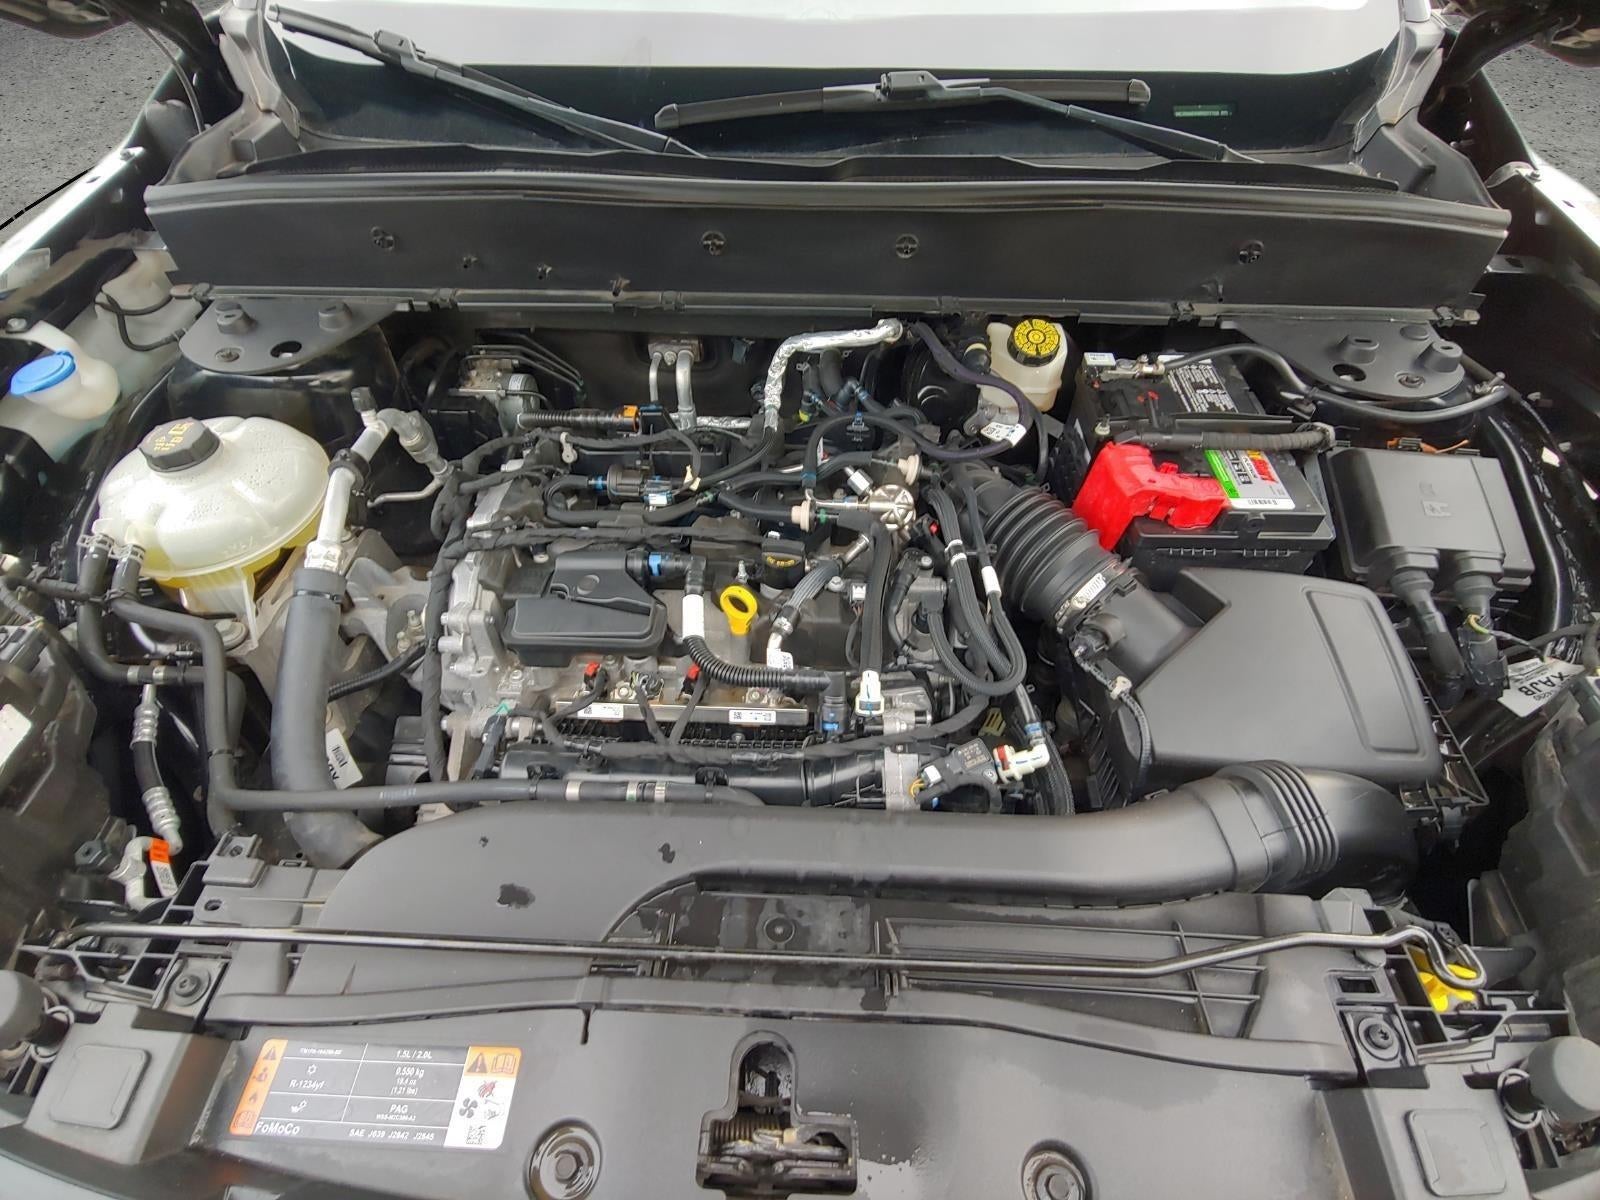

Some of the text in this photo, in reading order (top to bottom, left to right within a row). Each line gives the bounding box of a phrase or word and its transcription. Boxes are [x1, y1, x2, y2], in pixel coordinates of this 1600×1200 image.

[1518, 671, 1570, 696] XAJB
[396, 1050, 411, 1059] 1.5L
[417, 1050, 433, 1060] 2.0L
[395, 1066, 425, 1079] 0.550 kg
[289, 1079, 326, 1092] R-1234yf
[389, 1104, 409, 1114] PAG
[254, 1120, 301, 1135] FoMoCo
[349, 1128, 366, 1138] SAE
